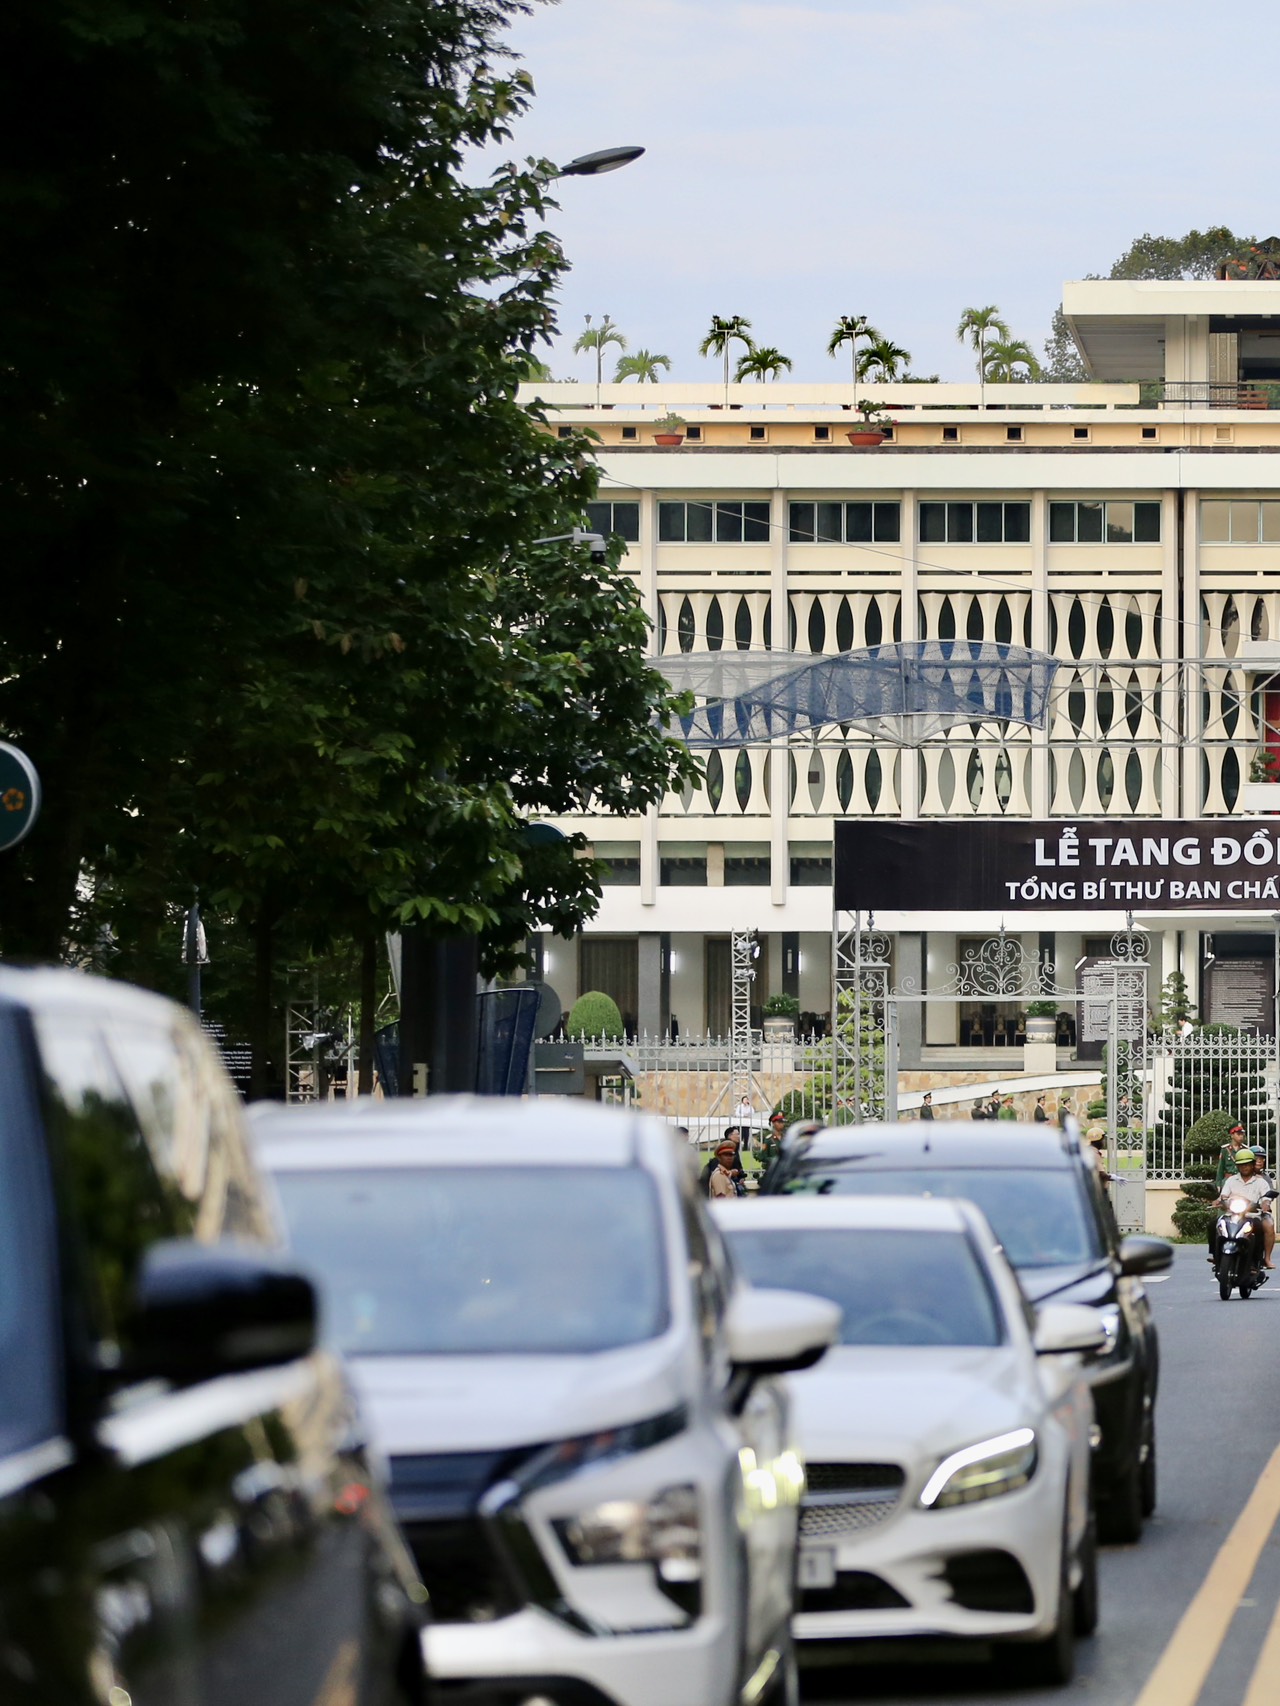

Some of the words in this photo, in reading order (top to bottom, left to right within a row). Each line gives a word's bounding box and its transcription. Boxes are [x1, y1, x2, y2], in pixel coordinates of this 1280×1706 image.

[1035, 827, 1080, 866] LỄ
[1089, 837, 1201, 866] TANG
[1006, 875, 1076, 900] TỔNG
[1083, 877, 1107, 900] BÍ
[1110, 879, 1165, 900] THƯ
[1170, 881, 1221, 899] BAN
